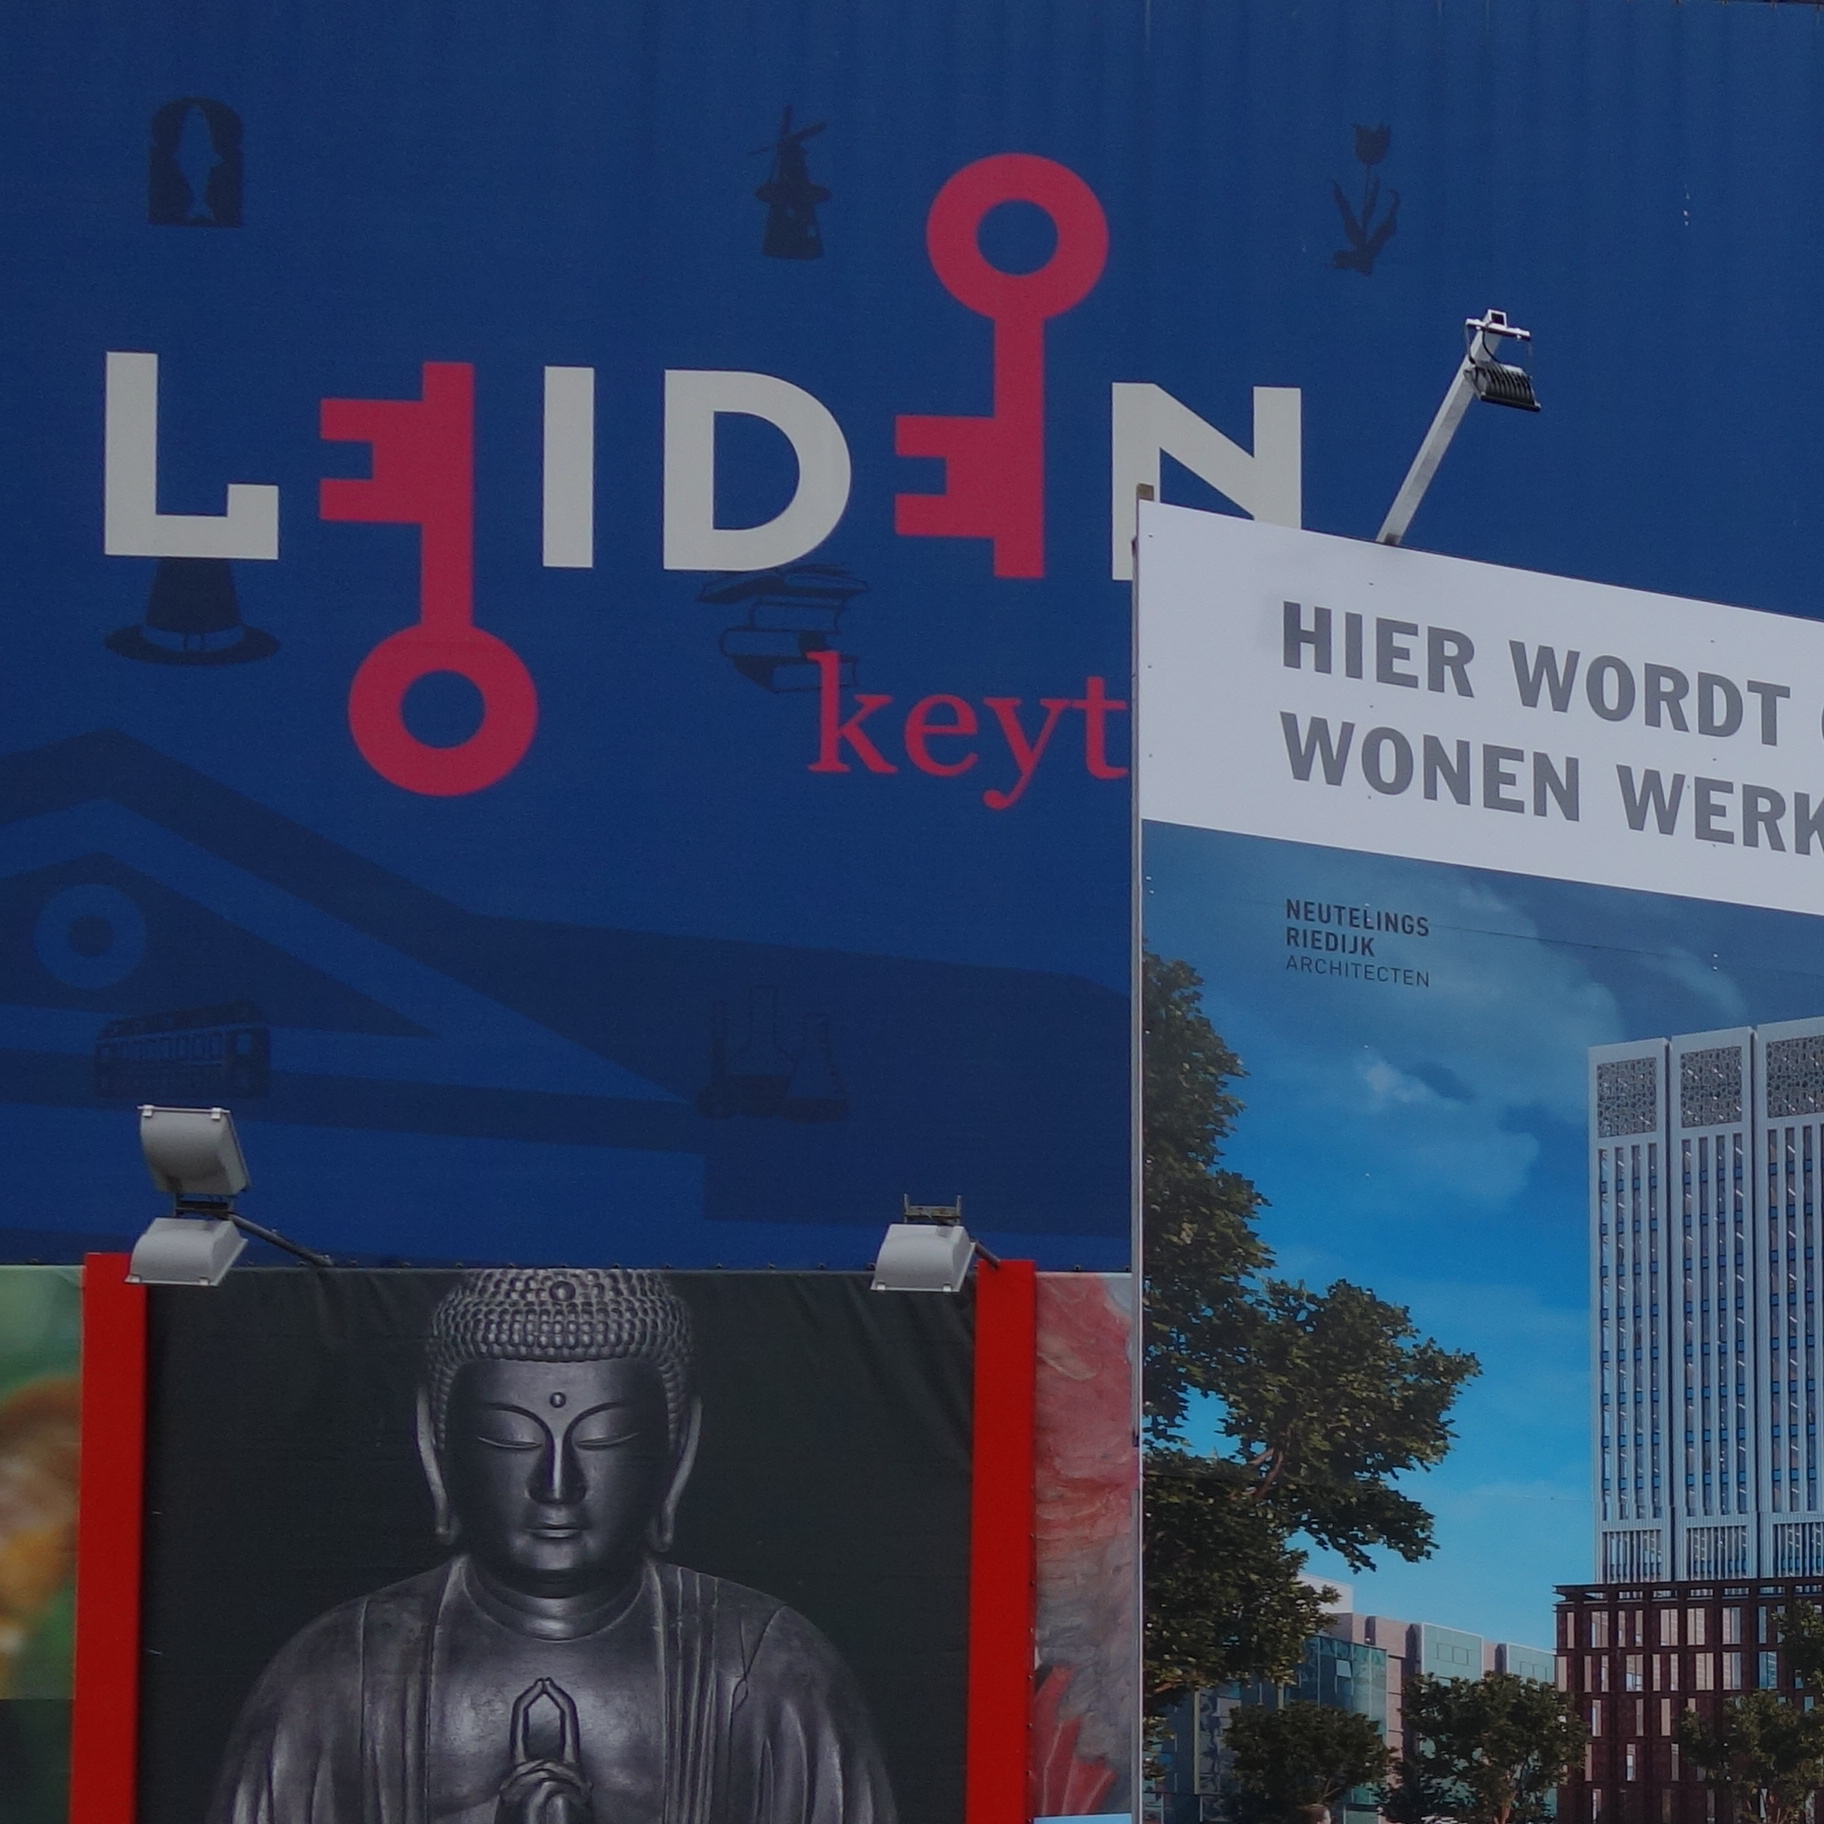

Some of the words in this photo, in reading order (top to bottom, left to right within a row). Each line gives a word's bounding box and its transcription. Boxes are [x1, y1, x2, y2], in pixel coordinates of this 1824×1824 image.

[1282, 600, 1476, 698] HIER
[1508, 640, 1790, 746] WORDT
[1280, 711, 1581, 822] WONEN
[1286, 898, 1429, 937] NEUTELINGS
[1286, 926, 1376, 957] RIEDIJK
[1286, 955, 1430, 988] ARCHITECTEN
